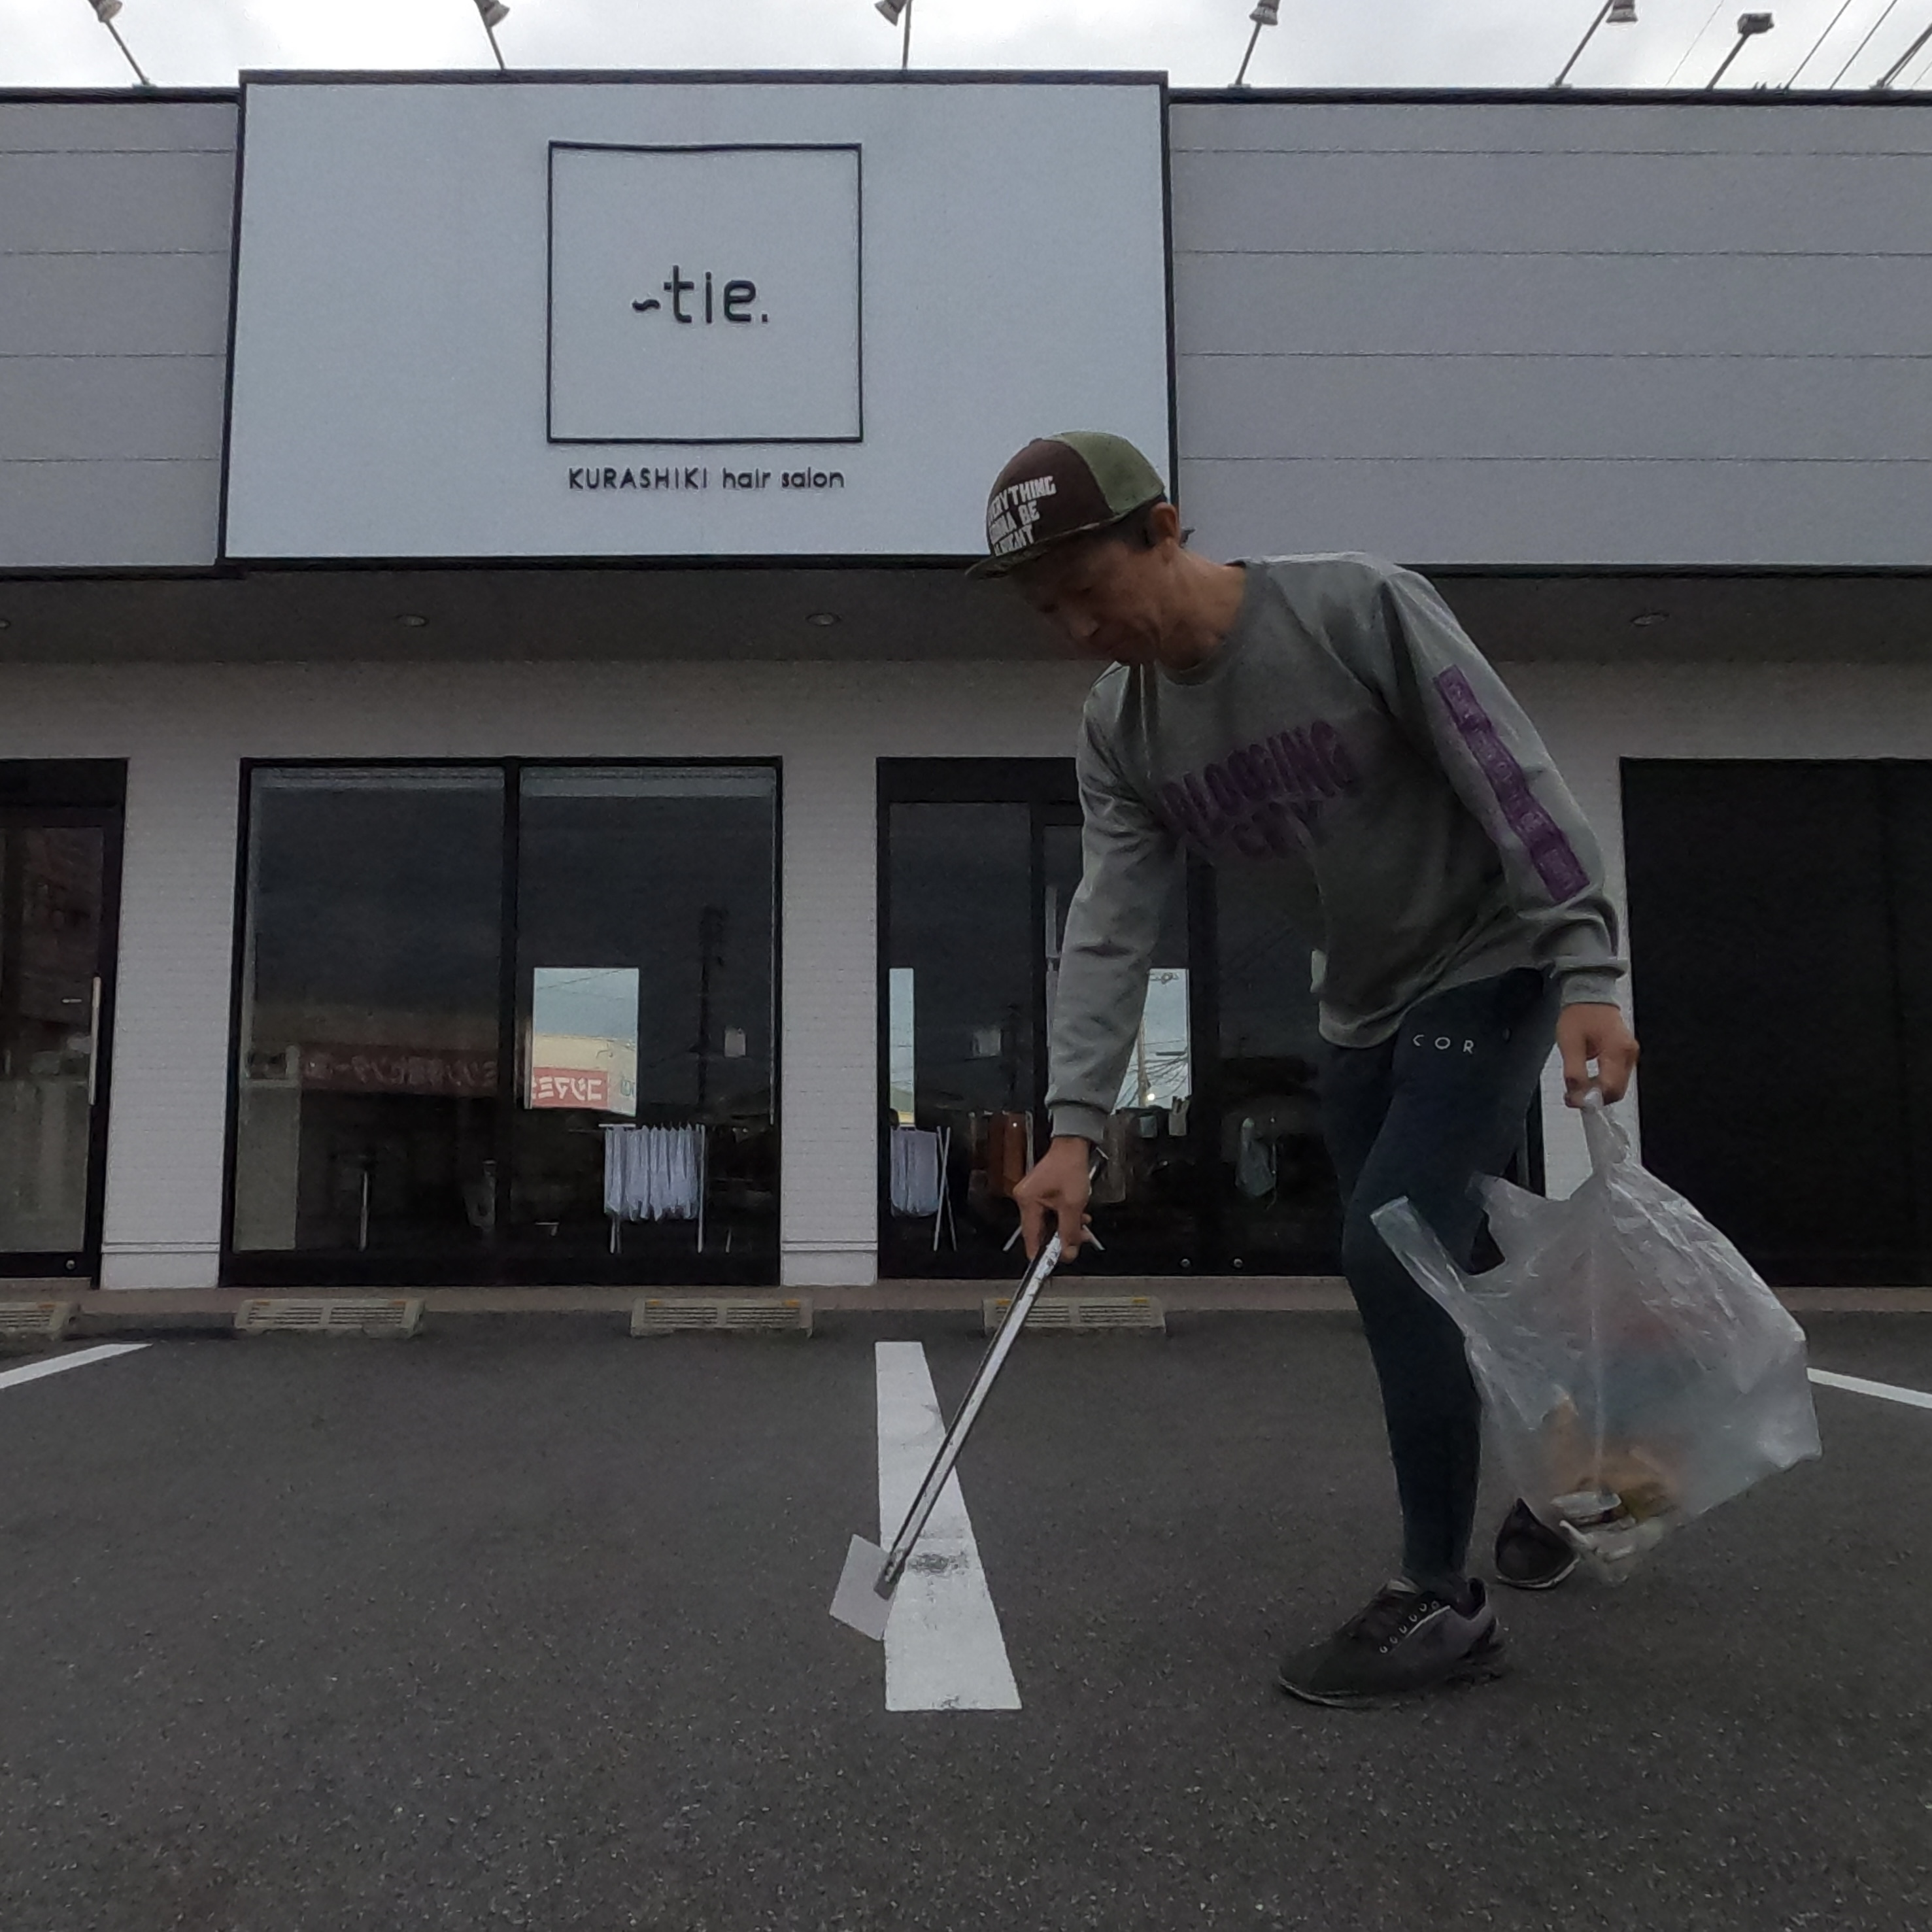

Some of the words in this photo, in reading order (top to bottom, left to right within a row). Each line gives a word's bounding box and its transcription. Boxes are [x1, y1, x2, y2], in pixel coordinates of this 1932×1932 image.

[569, 467, 707, 490] KURASHIKI
[722, 467, 771, 489] hair
[781, 467, 844, 489] salon
[1018, 500, 1040, 526] BE
